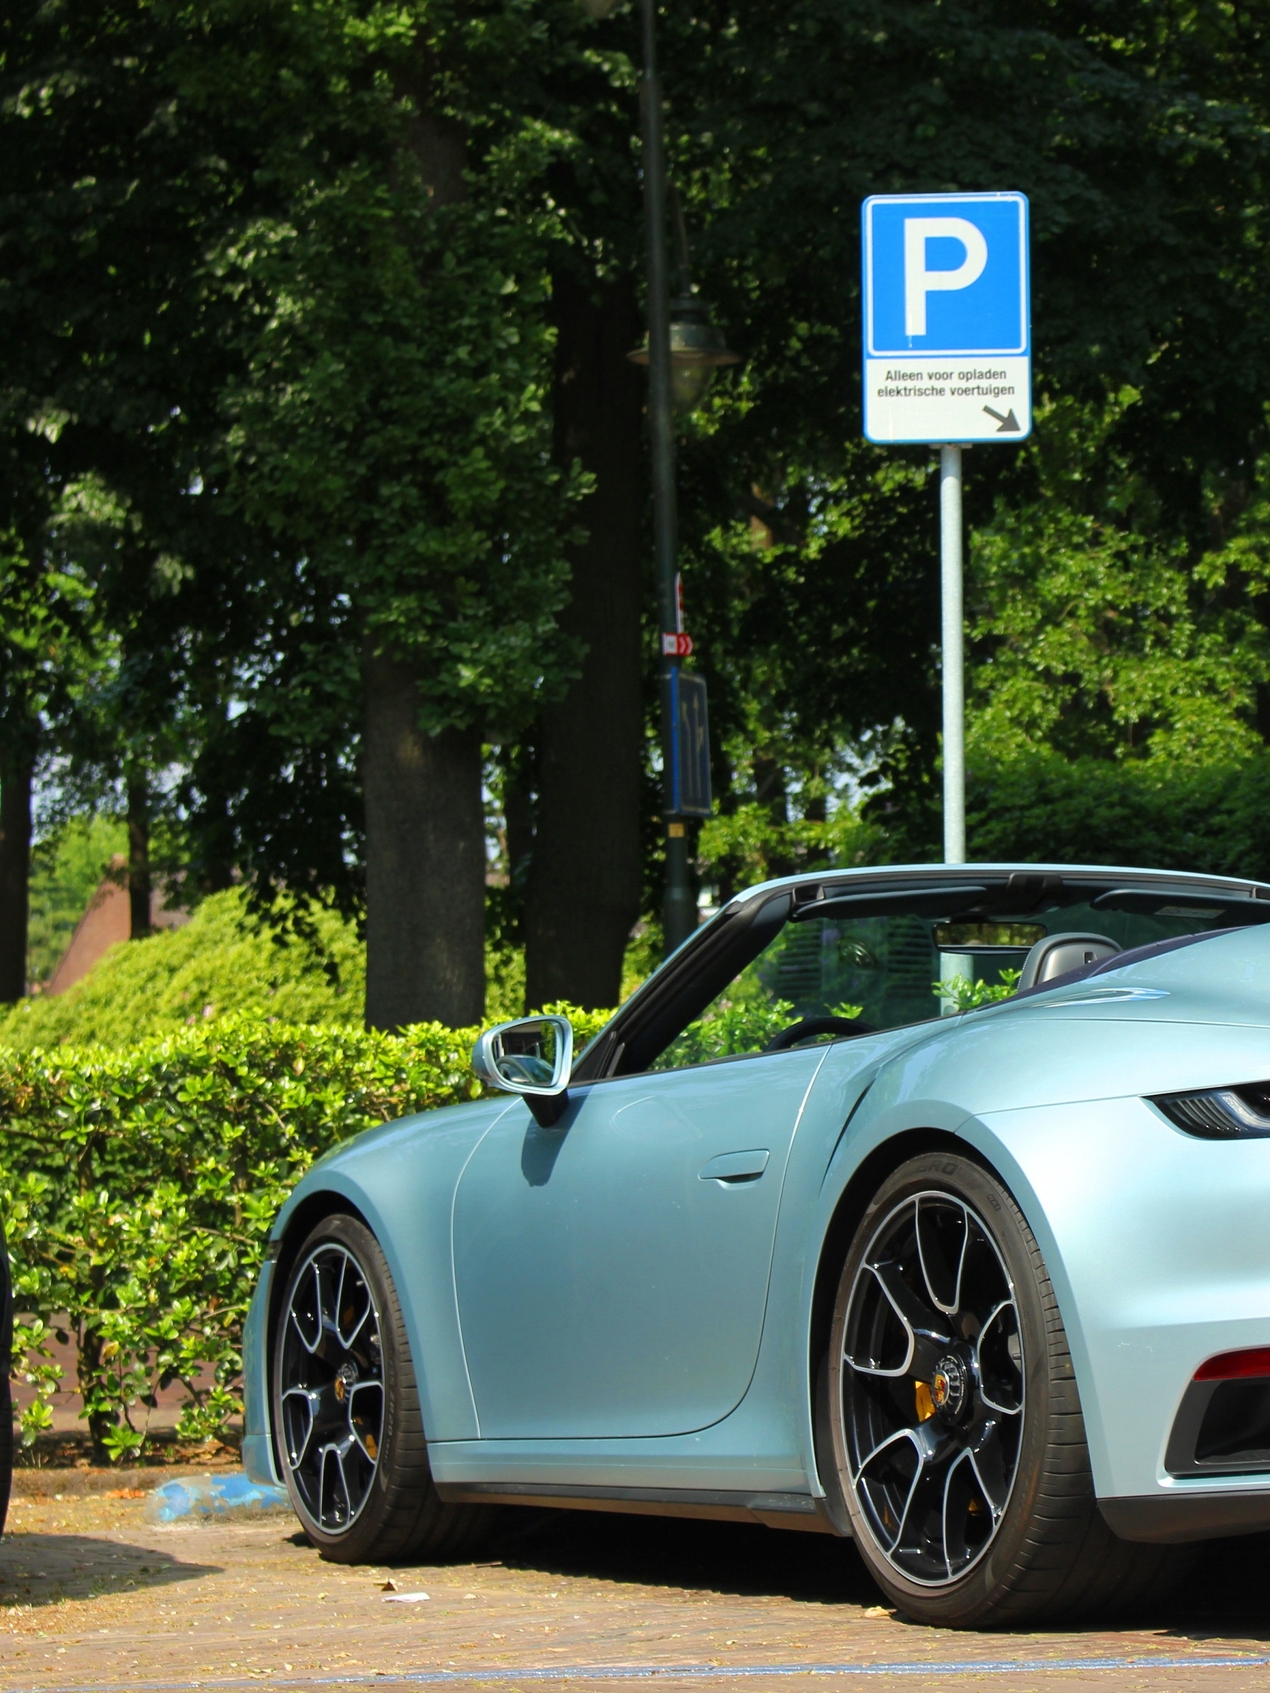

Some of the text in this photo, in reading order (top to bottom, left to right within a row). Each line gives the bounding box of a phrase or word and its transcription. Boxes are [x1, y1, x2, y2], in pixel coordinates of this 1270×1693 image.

[904, 217, 988, 336] P
[885, 369, 1007, 382] Alleen voor opladen
[877, 384, 1015, 398] elektrische voertuigen
